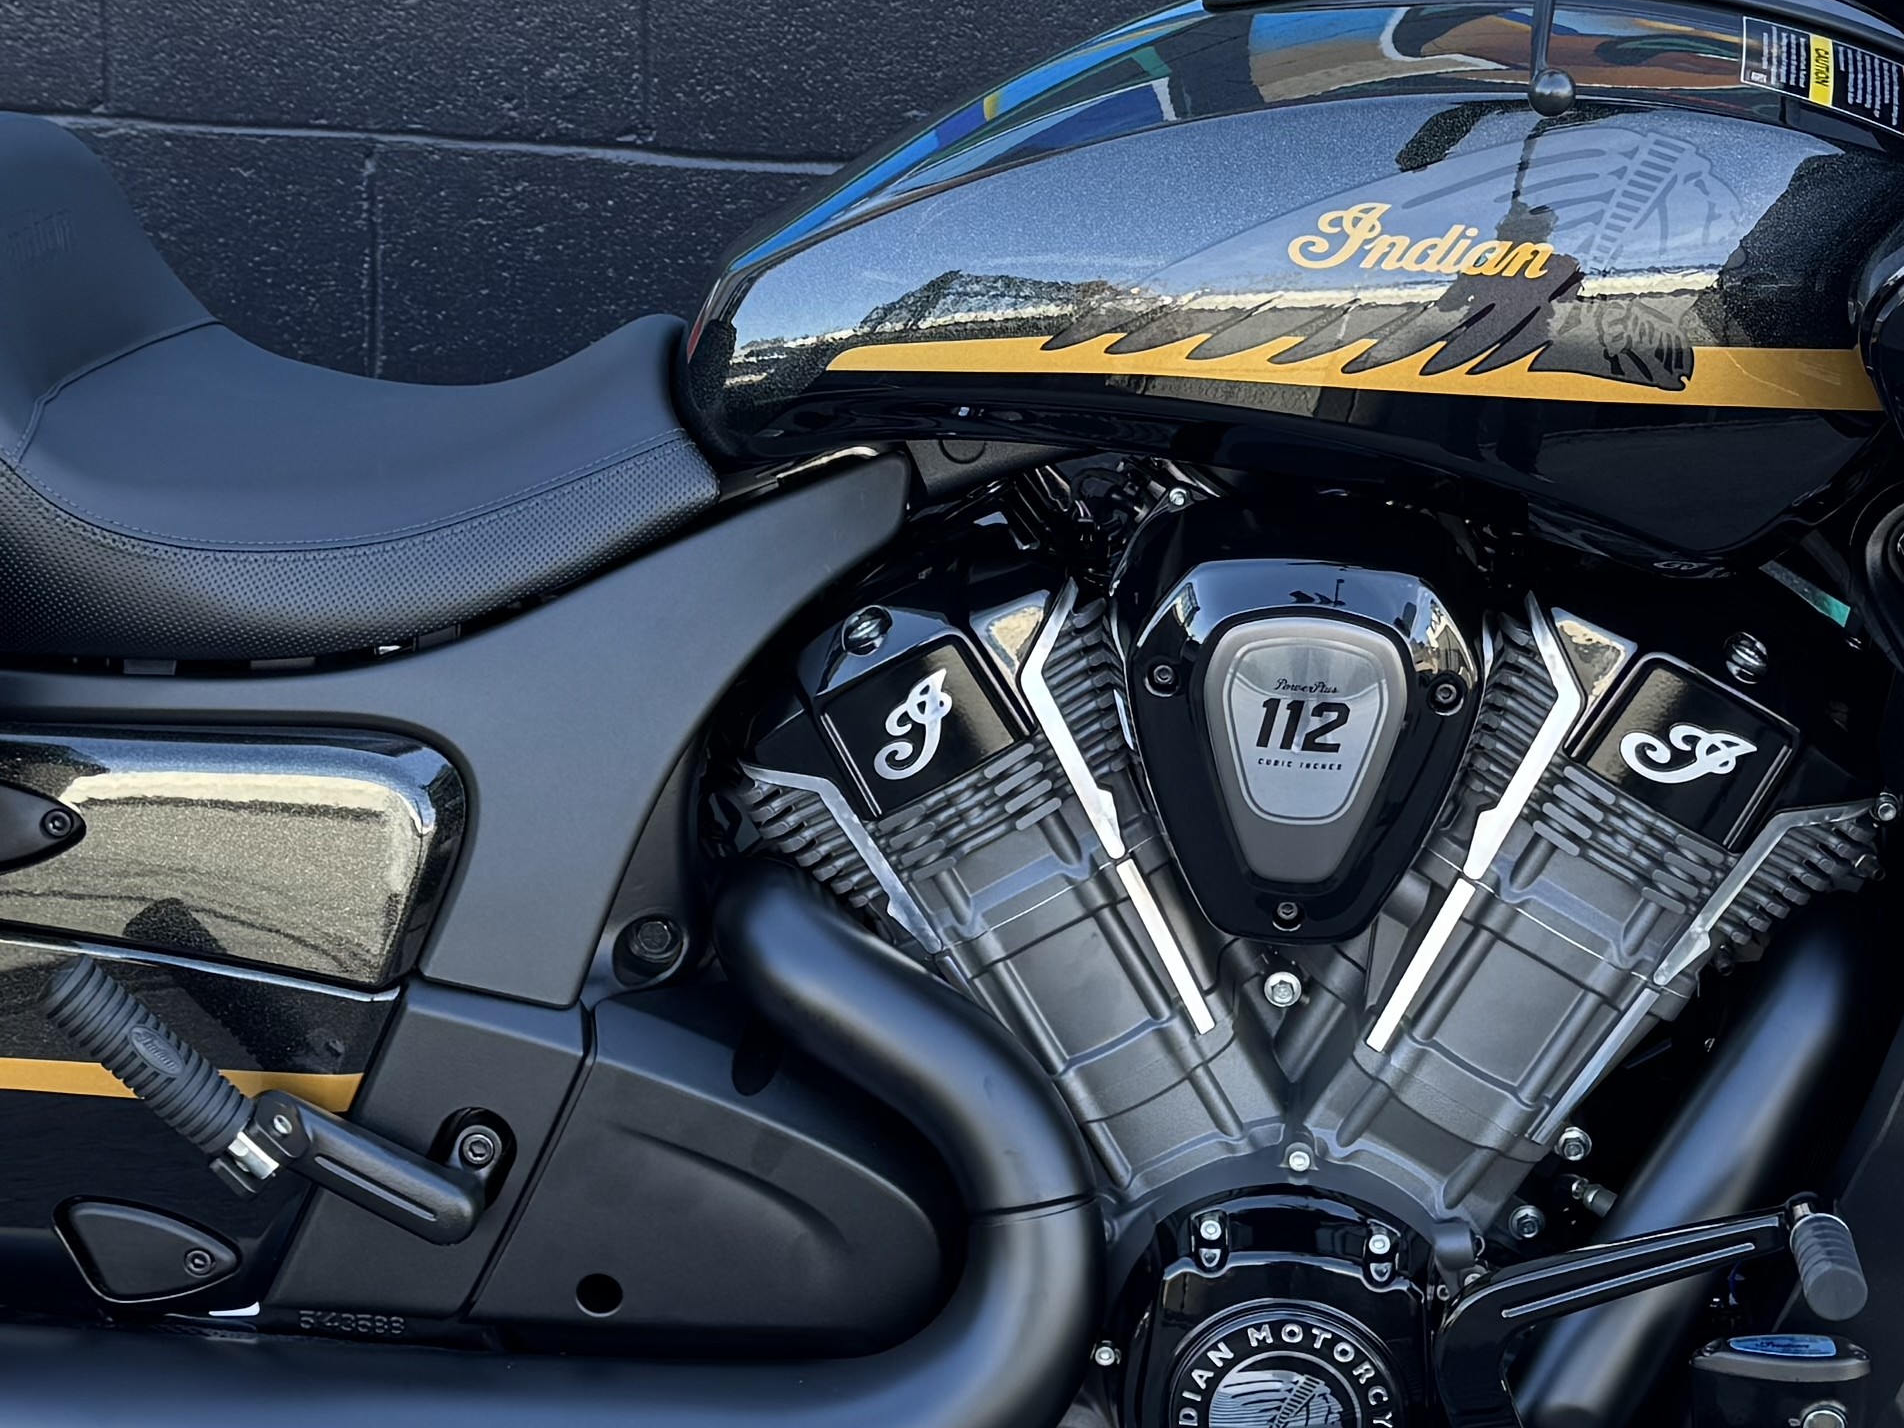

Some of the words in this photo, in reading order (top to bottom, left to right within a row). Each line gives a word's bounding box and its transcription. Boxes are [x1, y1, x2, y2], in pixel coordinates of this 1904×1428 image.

[1814, 47, 1830, 88] CAUTION
[1287, 202, 1555, 279] Indian
[1256, 698, 1351, 753] 112
[1258, 758, 1293, 768] CUBIC
[1299, 762, 1343, 771] INCHES
